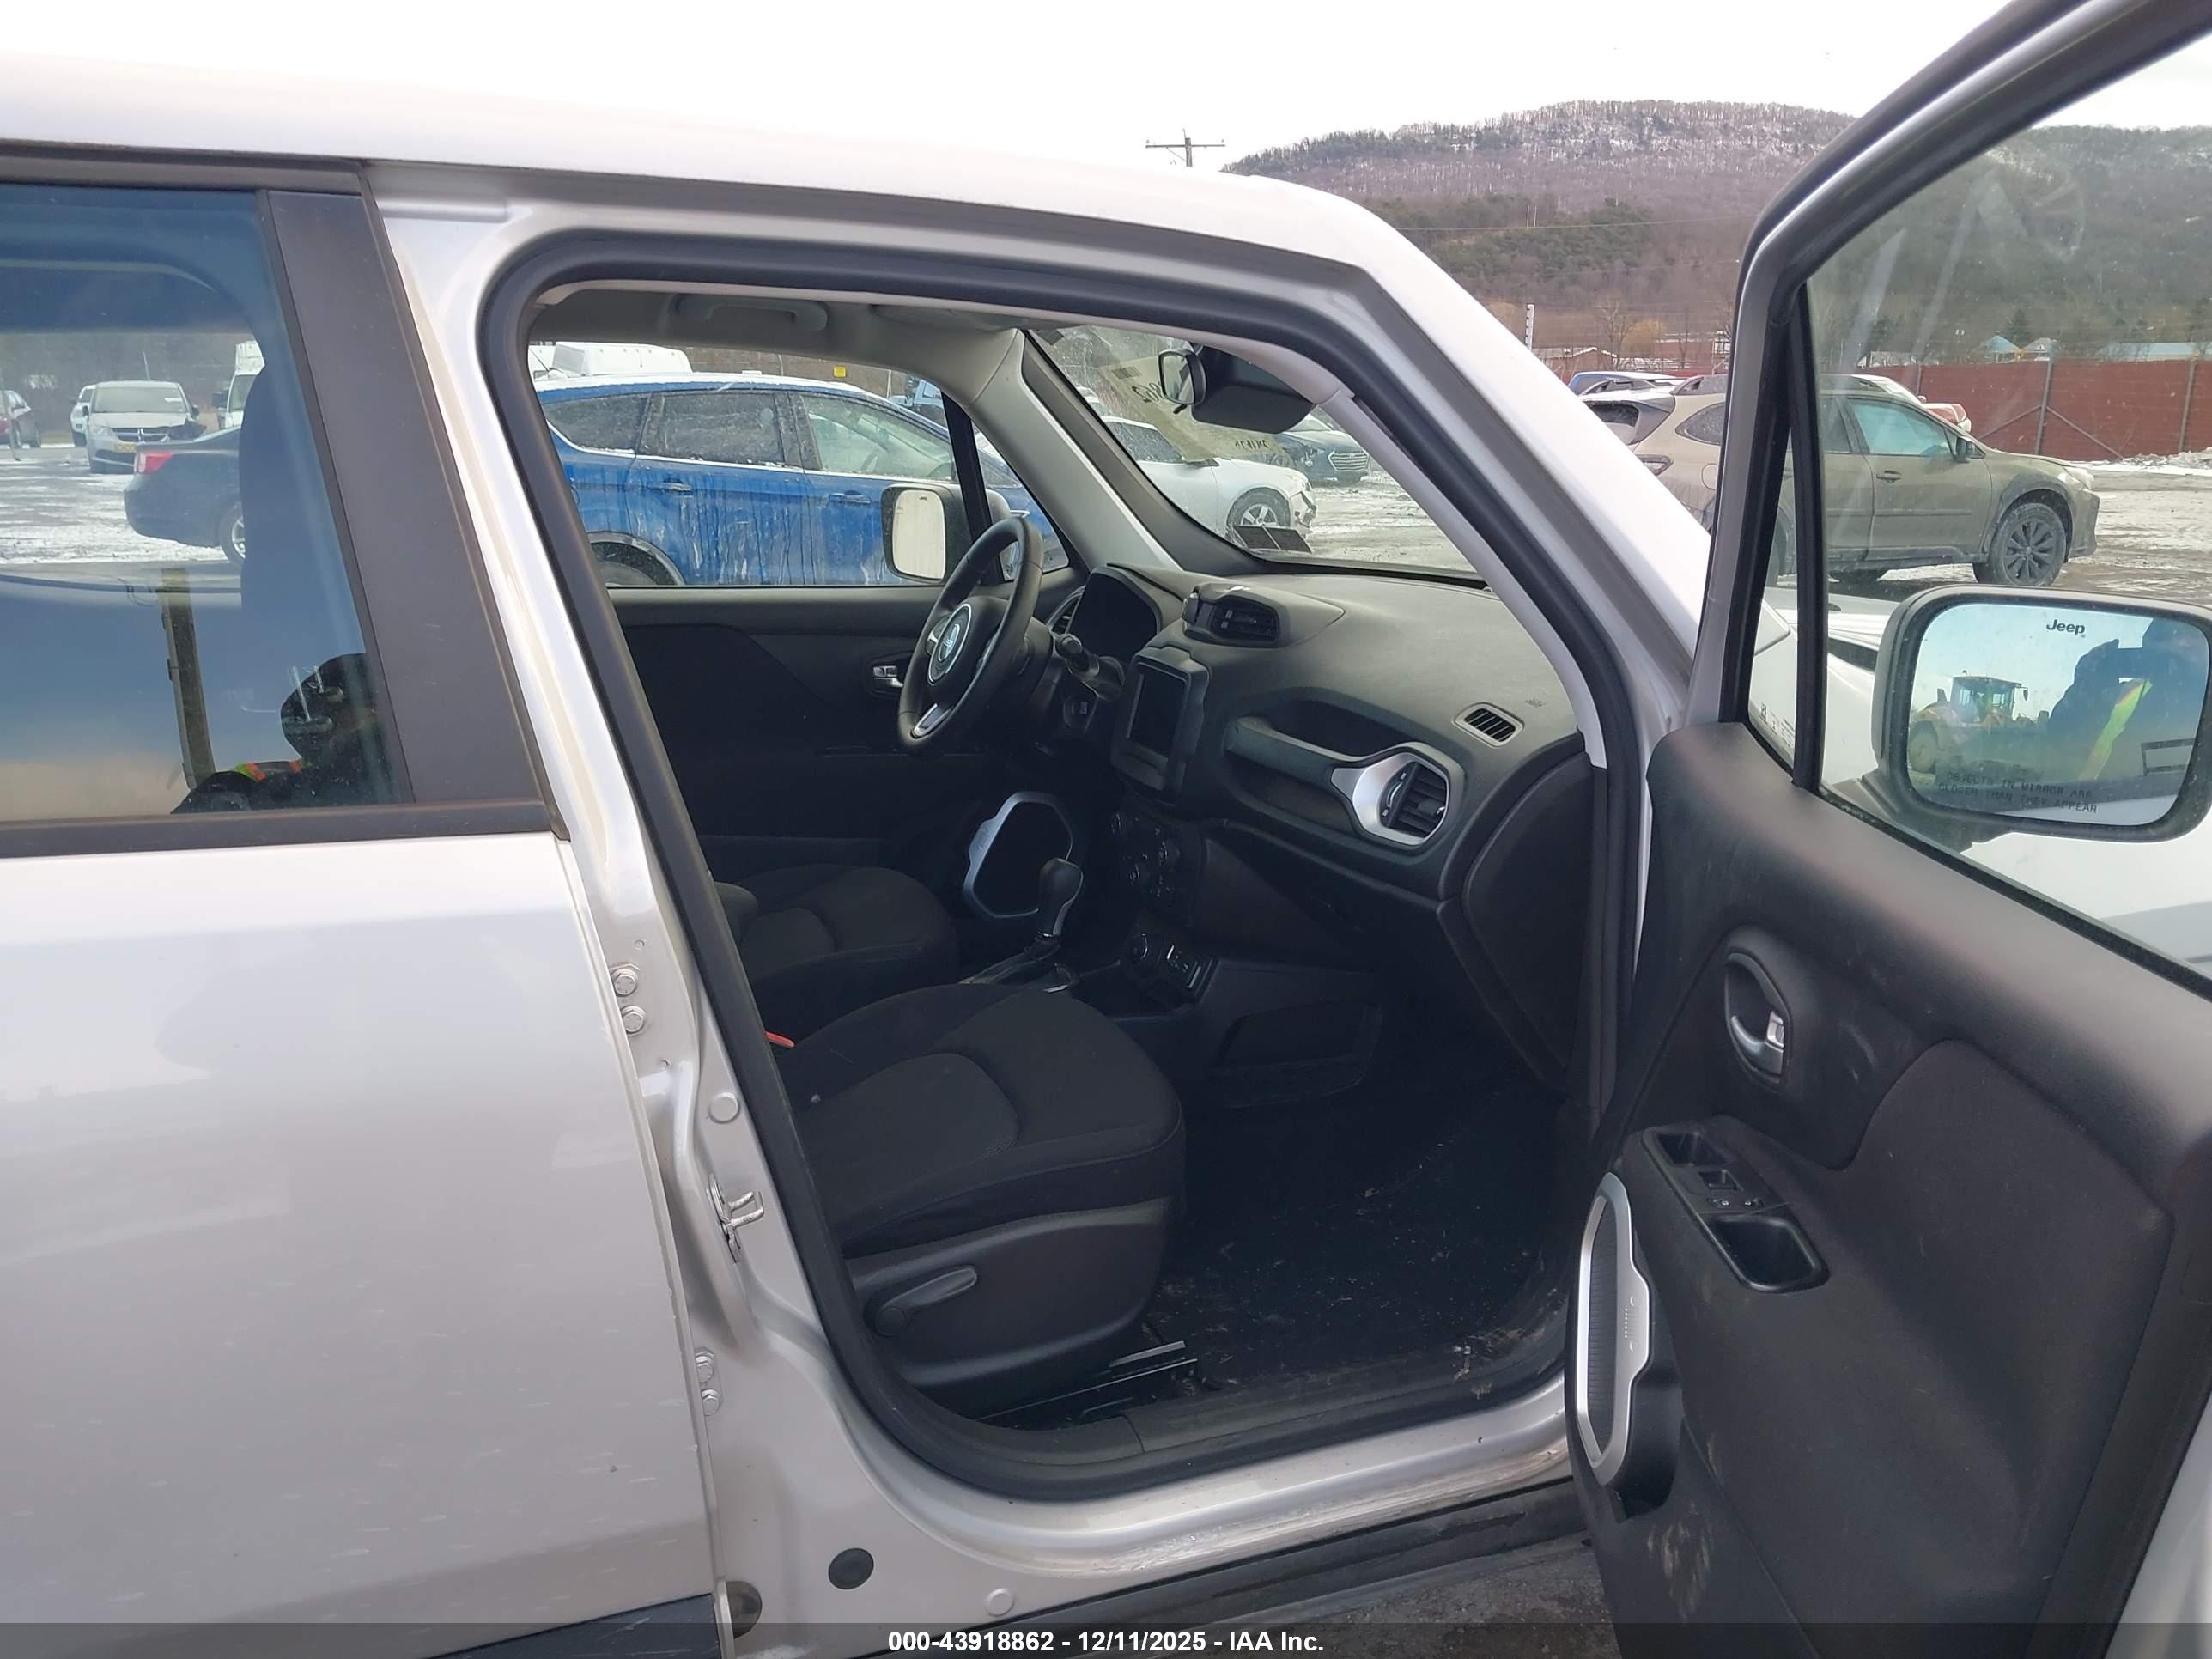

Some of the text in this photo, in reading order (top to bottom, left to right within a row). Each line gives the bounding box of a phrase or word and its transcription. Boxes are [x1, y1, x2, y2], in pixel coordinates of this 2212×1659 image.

[2045, 618, 2086, 636] Jeep
[1938, 783, 2097, 813] CLOSER THAN THEY APPEAR
[1947, 771, 2091, 799] OBJECTS IN MIRROR ARE
